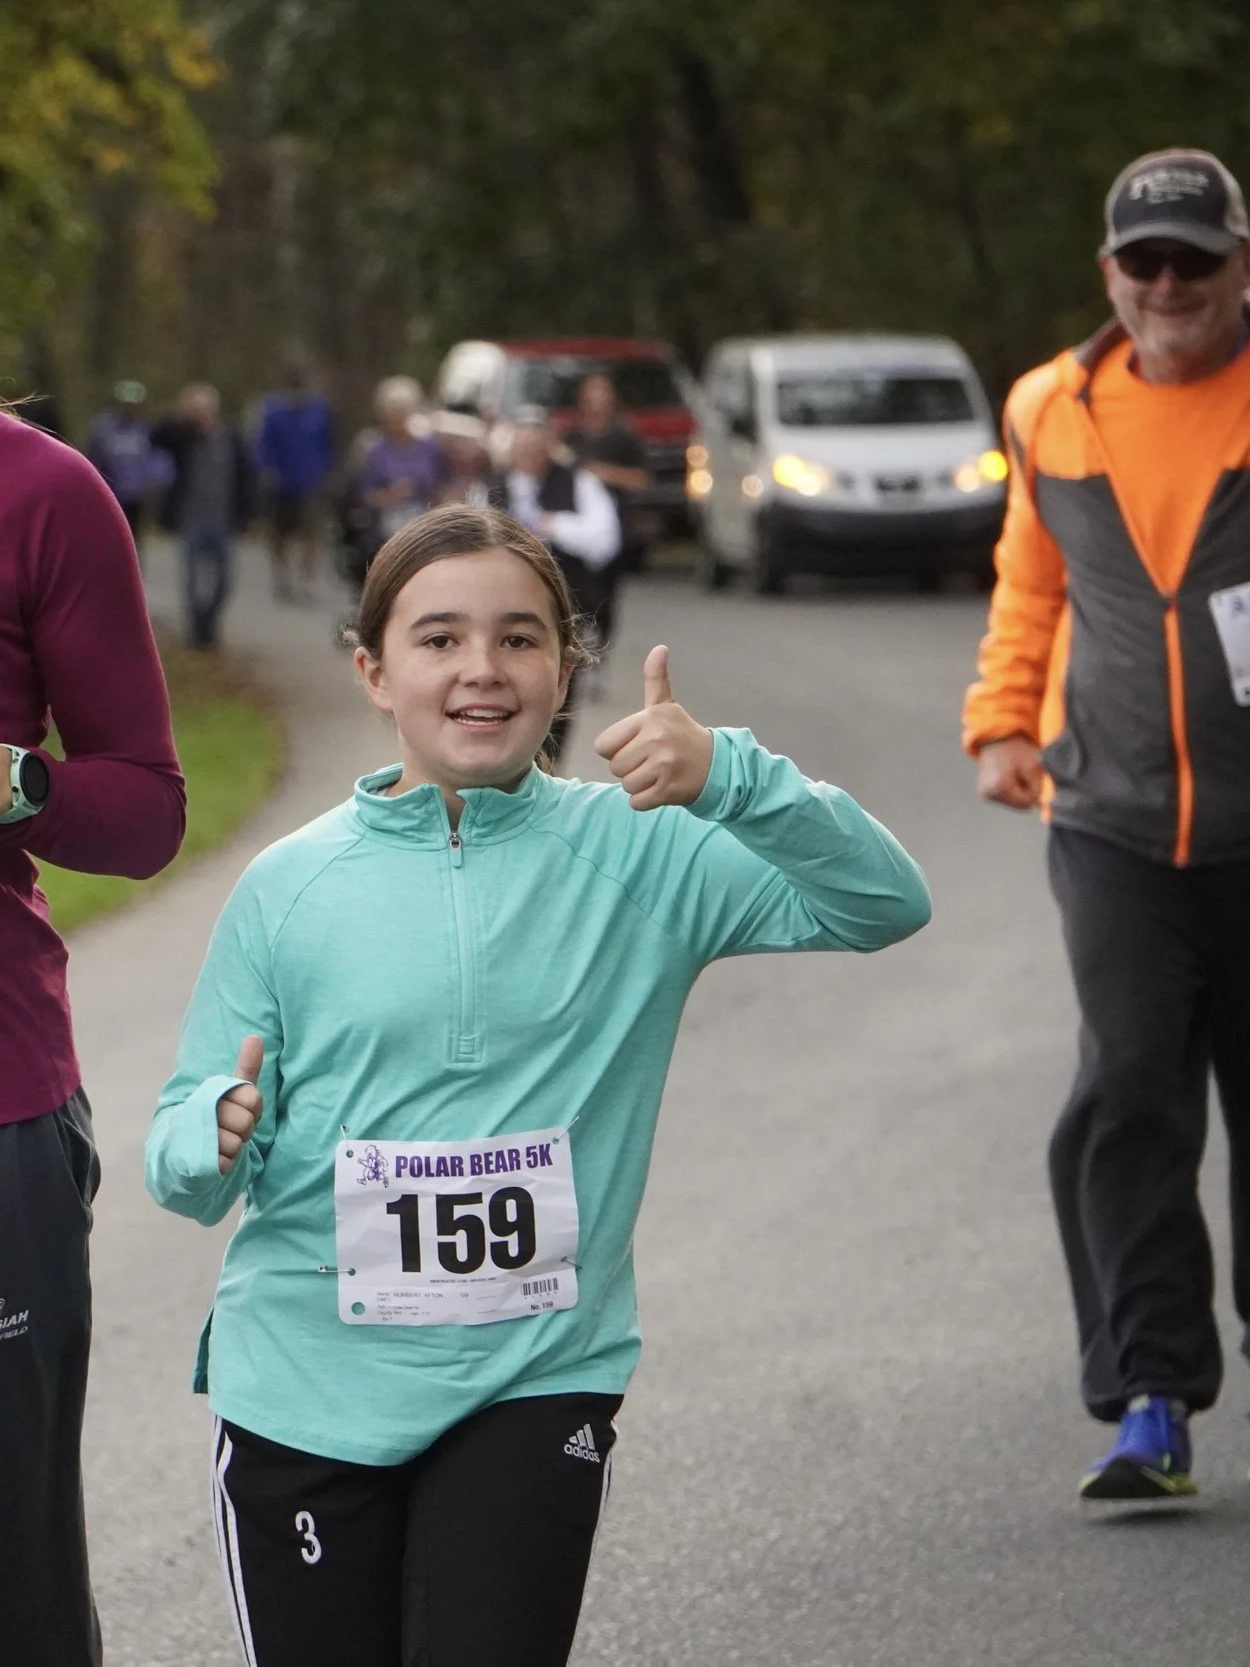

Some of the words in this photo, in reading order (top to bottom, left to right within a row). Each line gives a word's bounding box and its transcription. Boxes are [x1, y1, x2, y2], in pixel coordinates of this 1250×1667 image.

[395, 1155, 464, 1178] POLAR
[469, 1148, 521, 1177] BEAR
[525, 1143, 553, 1169] 5K
[386, 1186, 537, 1274] 159
[563, 1443, 600, 1463] adidas
[295, 1510, 322, 1564] 3
